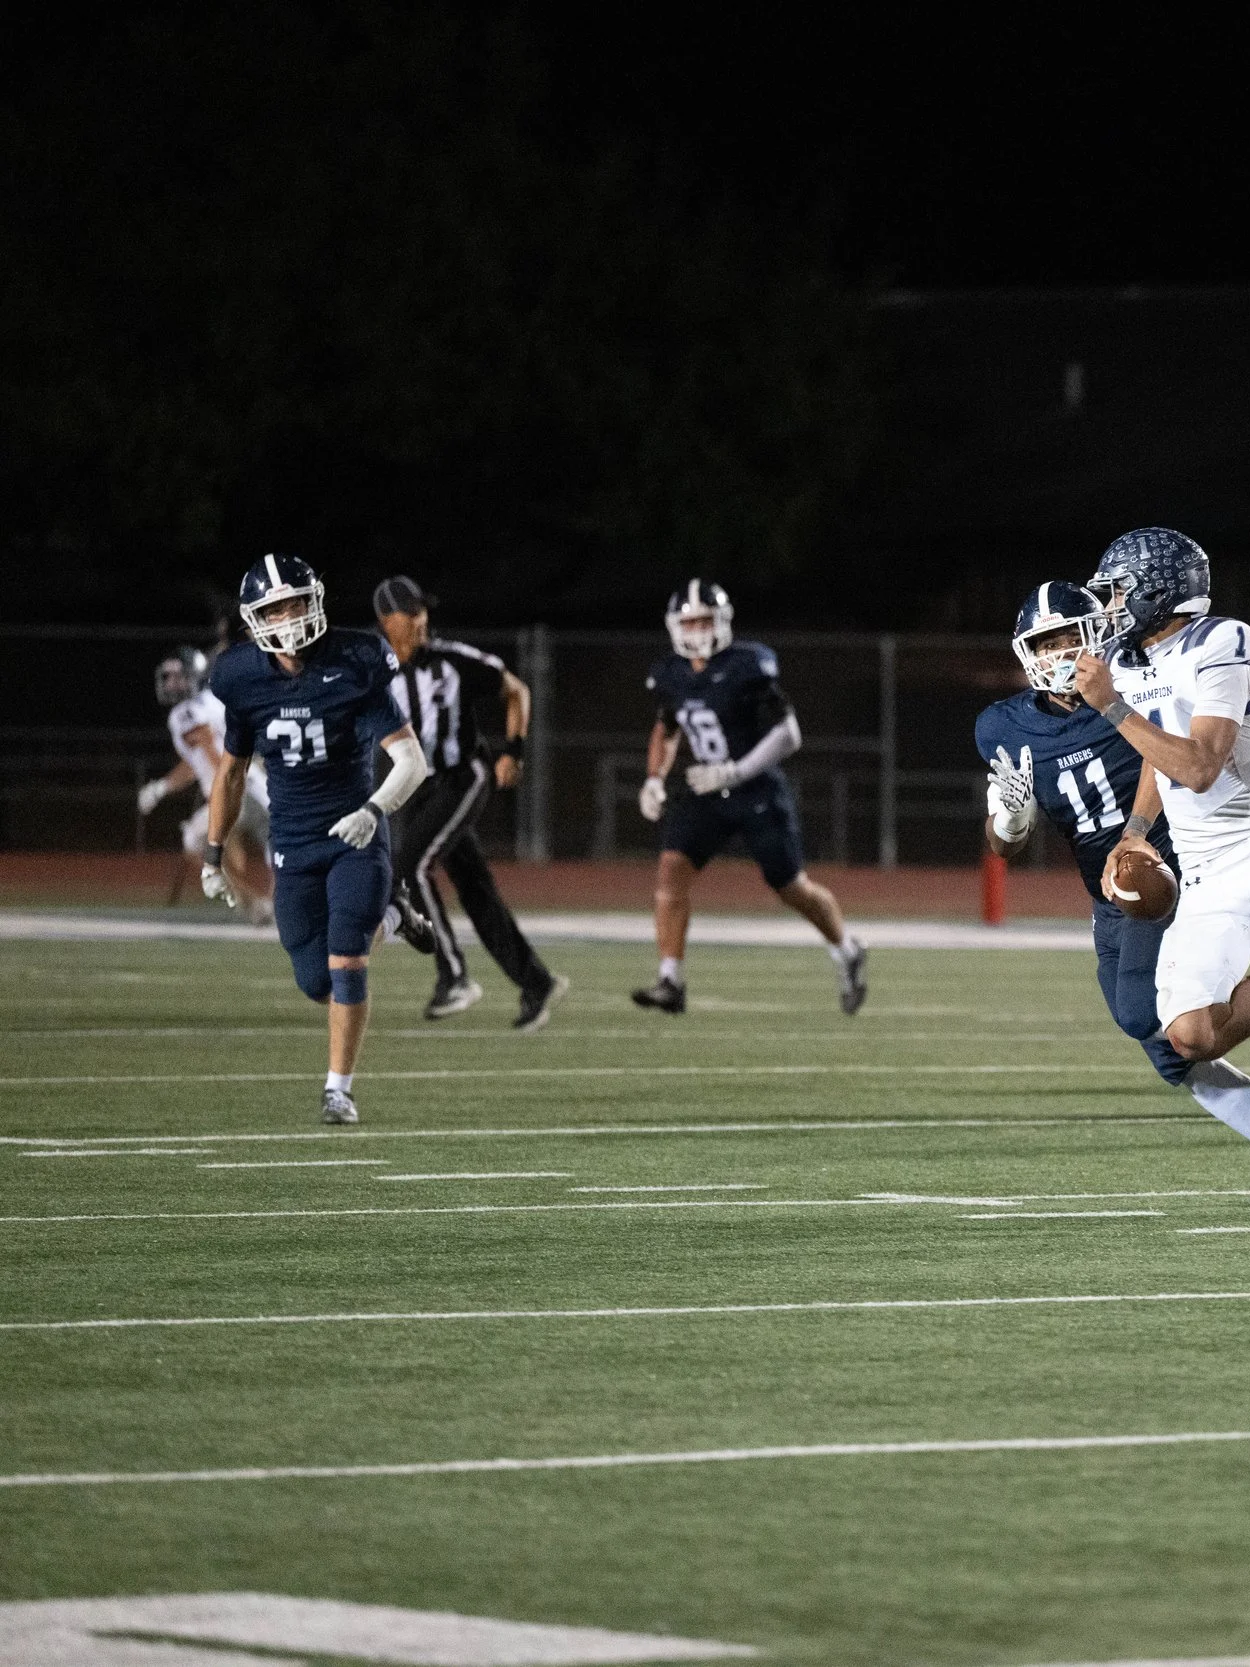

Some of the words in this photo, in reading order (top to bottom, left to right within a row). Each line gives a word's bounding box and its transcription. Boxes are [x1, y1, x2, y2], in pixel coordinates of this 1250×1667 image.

[1234, 625, 1246, 659] 1
[1131, 686, 1173, 705] CHAMPION
[266, 719, 328, 768] 31
[1056, 748, 1094, 770] RANGERS
[1057, 757, 1126, 834] 11
